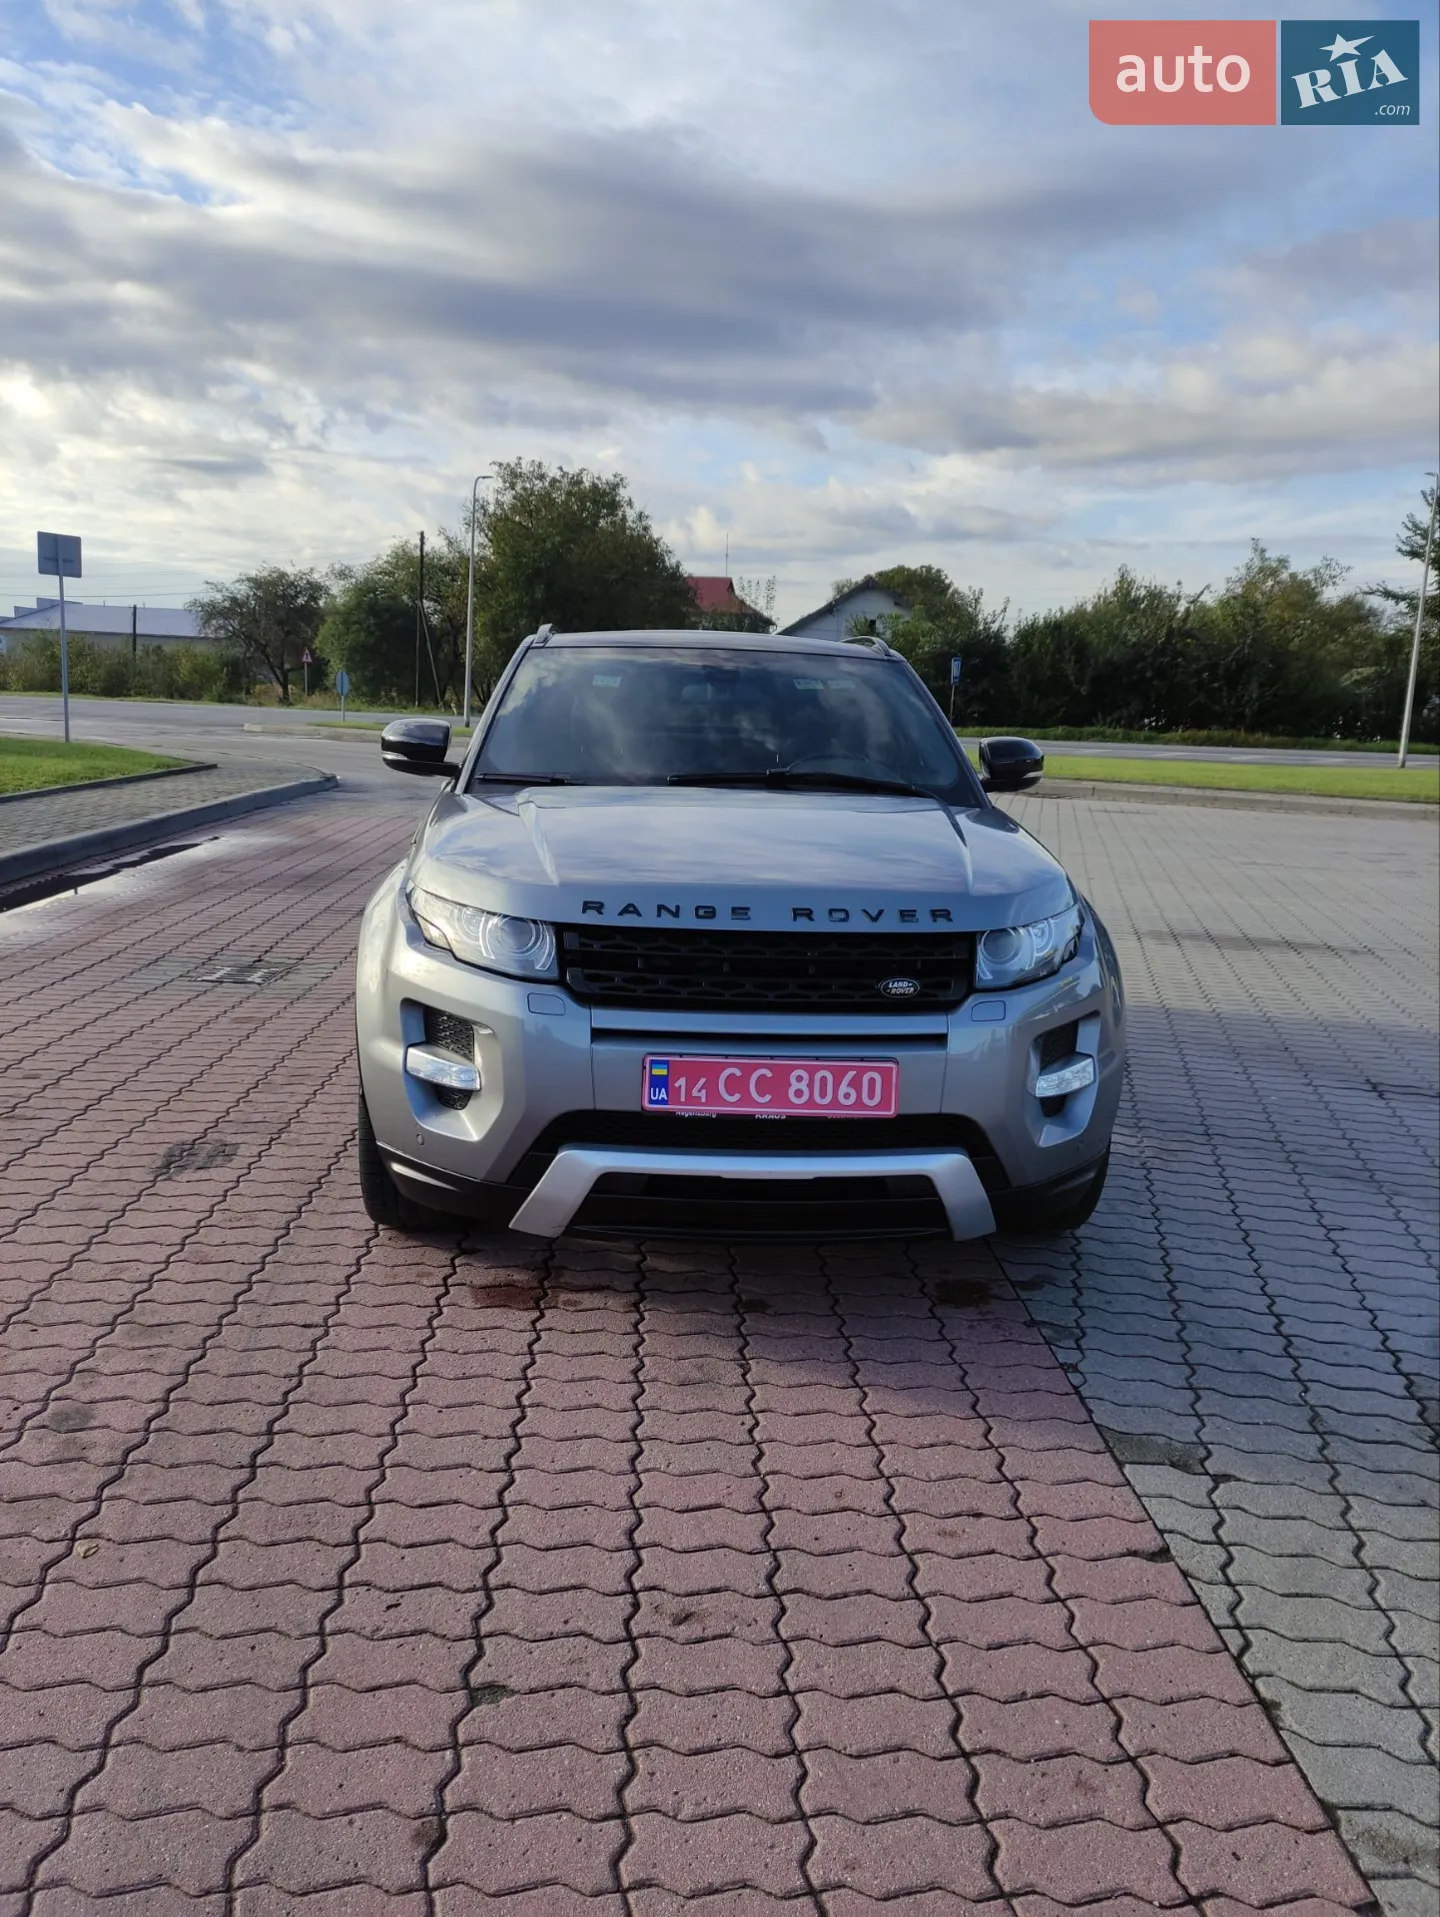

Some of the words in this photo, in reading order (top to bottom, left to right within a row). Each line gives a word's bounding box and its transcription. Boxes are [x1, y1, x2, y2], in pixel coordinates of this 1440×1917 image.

[581, 900, 751, 921] RANGE
[791, 907, 953, 924] ROVER
[650, 1087, 667, 1101] UA
[673, 1076, 707, 1103] 14
[718, 1067, 773, 1104] CC
[787, 1068, 883, 1107] 8060
